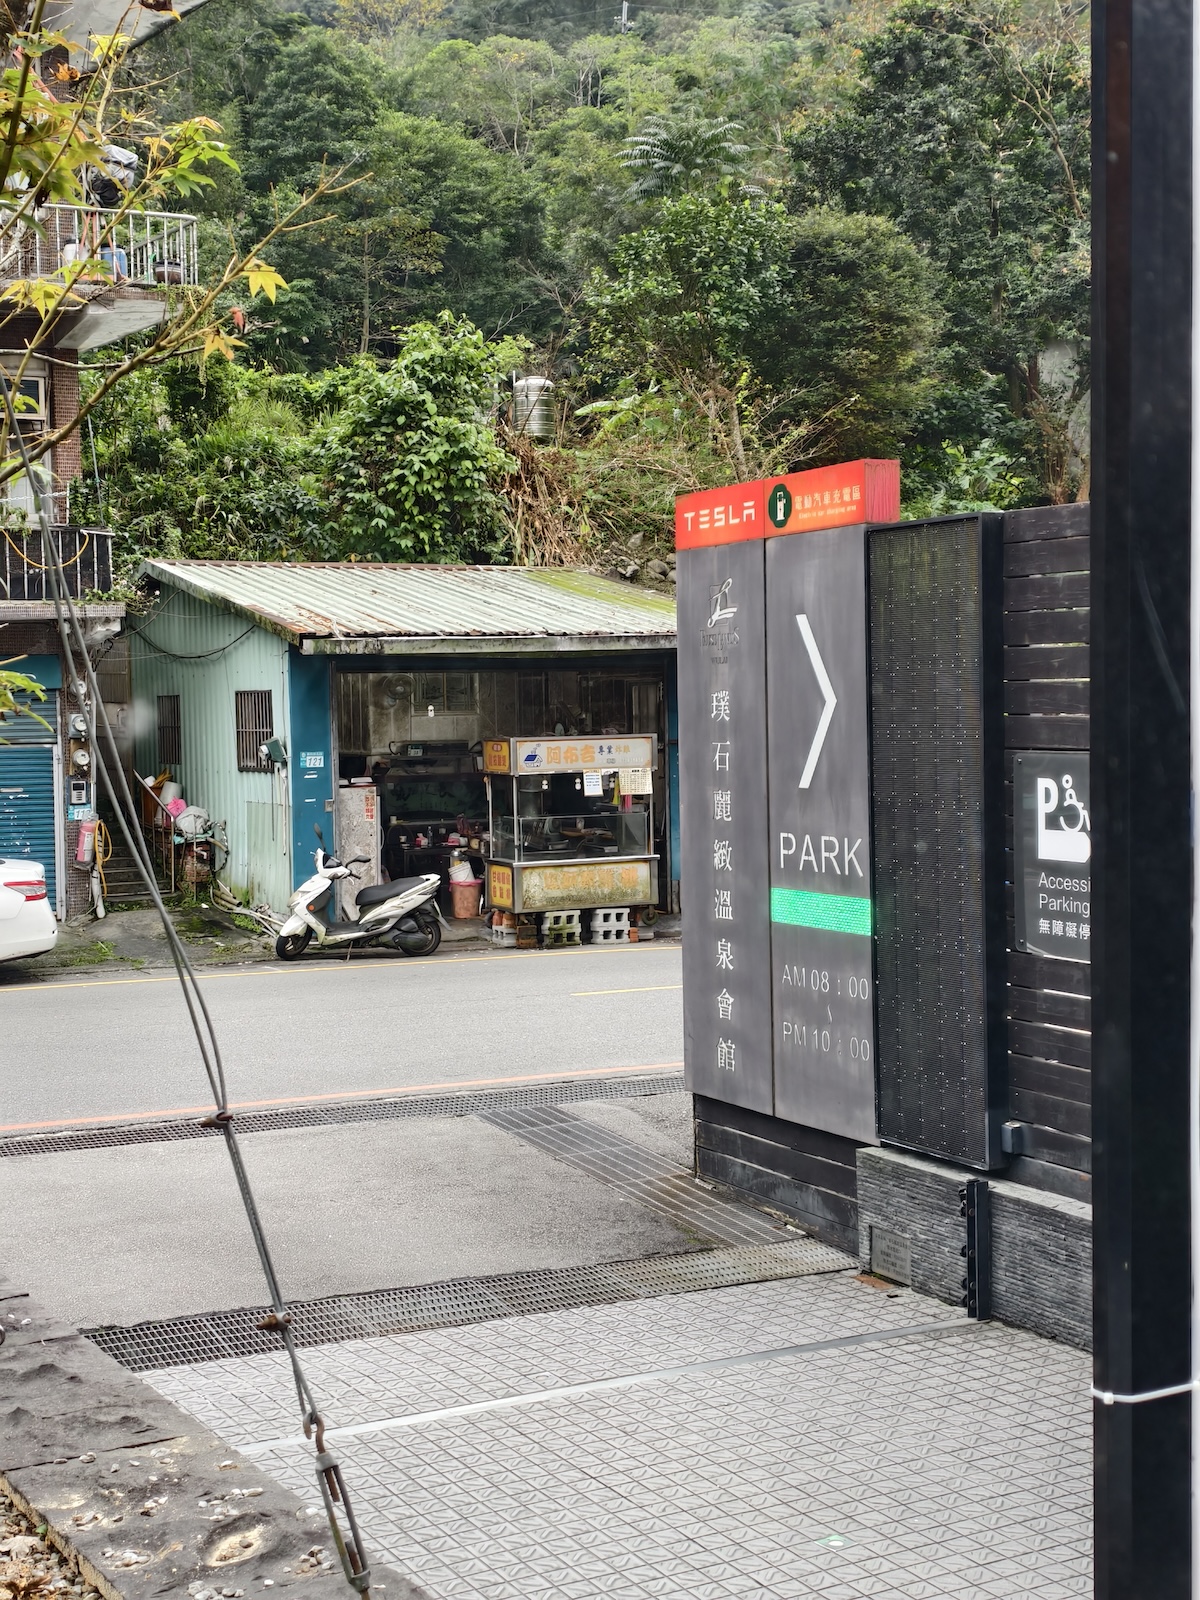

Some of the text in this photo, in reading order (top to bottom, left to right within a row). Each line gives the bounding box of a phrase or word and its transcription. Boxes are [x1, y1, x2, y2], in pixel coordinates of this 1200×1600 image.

[794, 485, 861, 510] 電動汽車充電區
[684, 501, 756, 531] TESLA
[307, 757, 322, 766] 121
[779, 832, 864, 879] PARK
[710, 690, 736, 1072] 璞石麗緻溫泉會館
[1039, 893, 1091, 918] Parking
[782, 964, 806, 988] AM
[782, 1021, 807, 1047] PM
